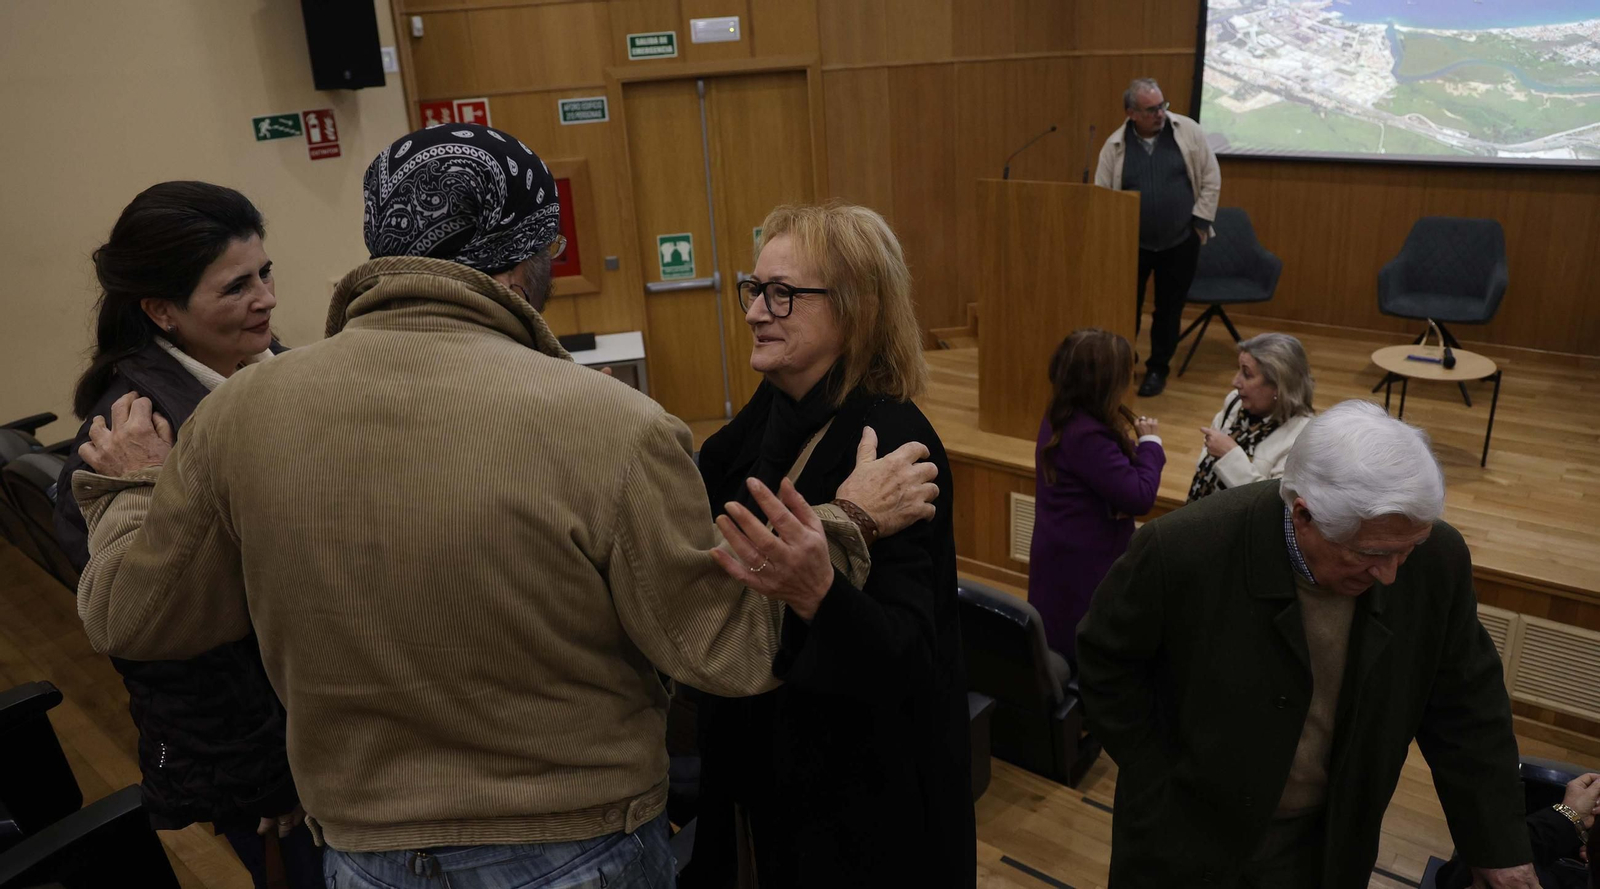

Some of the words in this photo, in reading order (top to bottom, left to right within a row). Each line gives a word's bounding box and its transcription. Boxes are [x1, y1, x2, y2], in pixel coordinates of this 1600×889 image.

[635, 37, 658, 46] SALIDA
[659, 36, 668, 45] DE
[632, 45, 673, 55] EMERGENCIA
